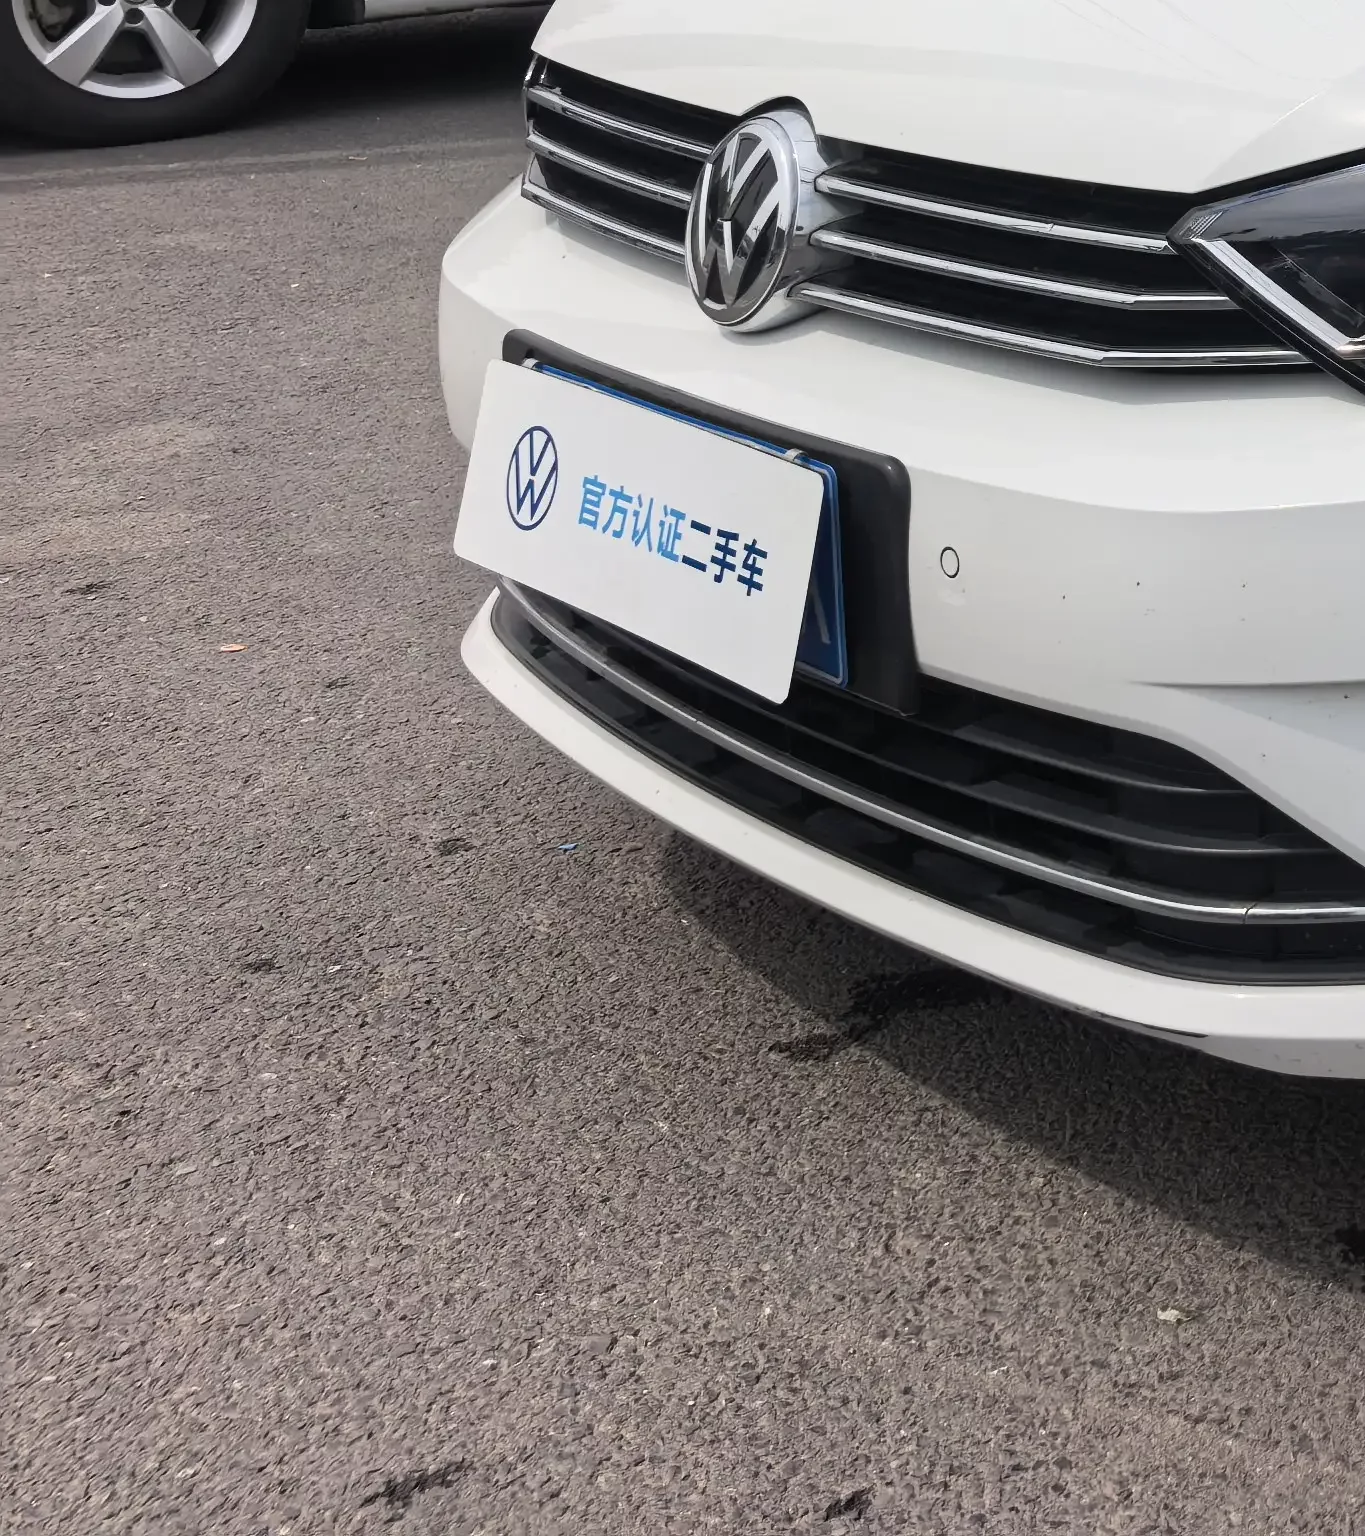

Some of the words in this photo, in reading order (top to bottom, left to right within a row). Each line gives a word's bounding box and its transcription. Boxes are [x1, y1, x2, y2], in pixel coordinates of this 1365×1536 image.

[578, 474, 768, 597] 官方认证二手车
